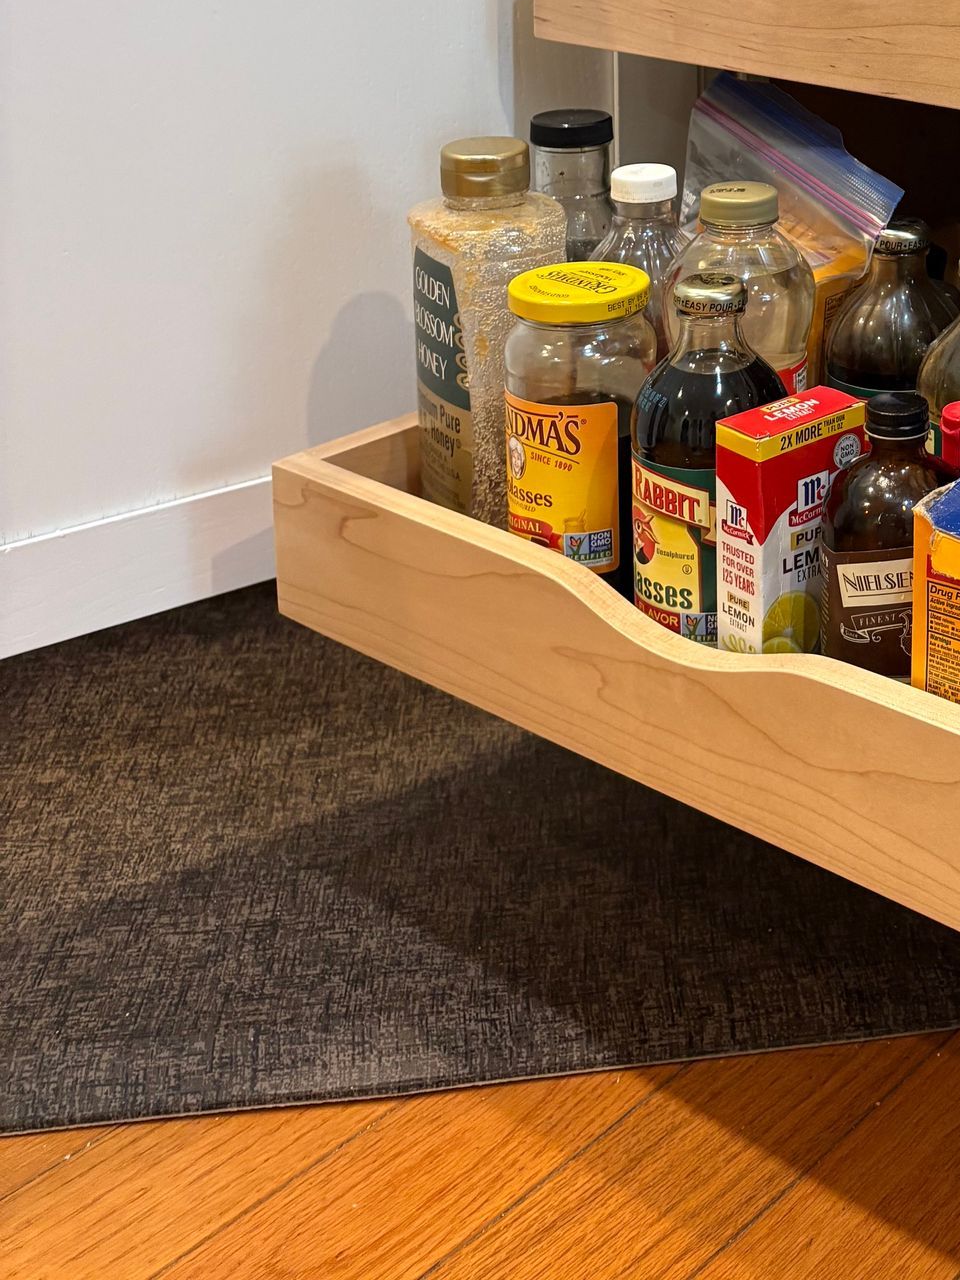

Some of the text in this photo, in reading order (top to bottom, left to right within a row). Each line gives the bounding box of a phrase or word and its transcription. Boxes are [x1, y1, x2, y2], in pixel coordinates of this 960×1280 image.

[880, 240, 903, 251] POUR
[415, 265, 450, 310] GOLDEN
[607, 300, 625, 312] BEST
[685, 300, 733, 312] EASY POUR
[414, 300, 453, 348] BLOSSOM
[418, 340, 448, 381] HONEY
[763, 398, 821, 421] LEMON
[439, 403, 461, 434] Pure
[823, 416, 836, 427] THAN
[780, 422, 823, 451] 2X MORE
[840, 448, 855, 460] GMO
[841, 441, 854, 452] NON
[530, 451, 573, 472] SINCE 1890
[635, 464, 701, 523] RABBIT
[591, 531, 611, 541] NON
[723, 523, 751, 540] McCormick
[590, 538, 611, 548] GMO
[722, 540, 755, 566] TRUSTED
[722, 554, 755, 579] FOR OVER
[722, 567, 755, 597] 125 YEARS
[929, 584, 953, 600] Drug
[729, 594, 749, 610] PURE
[929, 597, 945, 607] Active
[722, 601, 755, 628] LEMON
[859, 613, 896, 628] FINEST
[729, 618, 748, 633] EXTRACT
